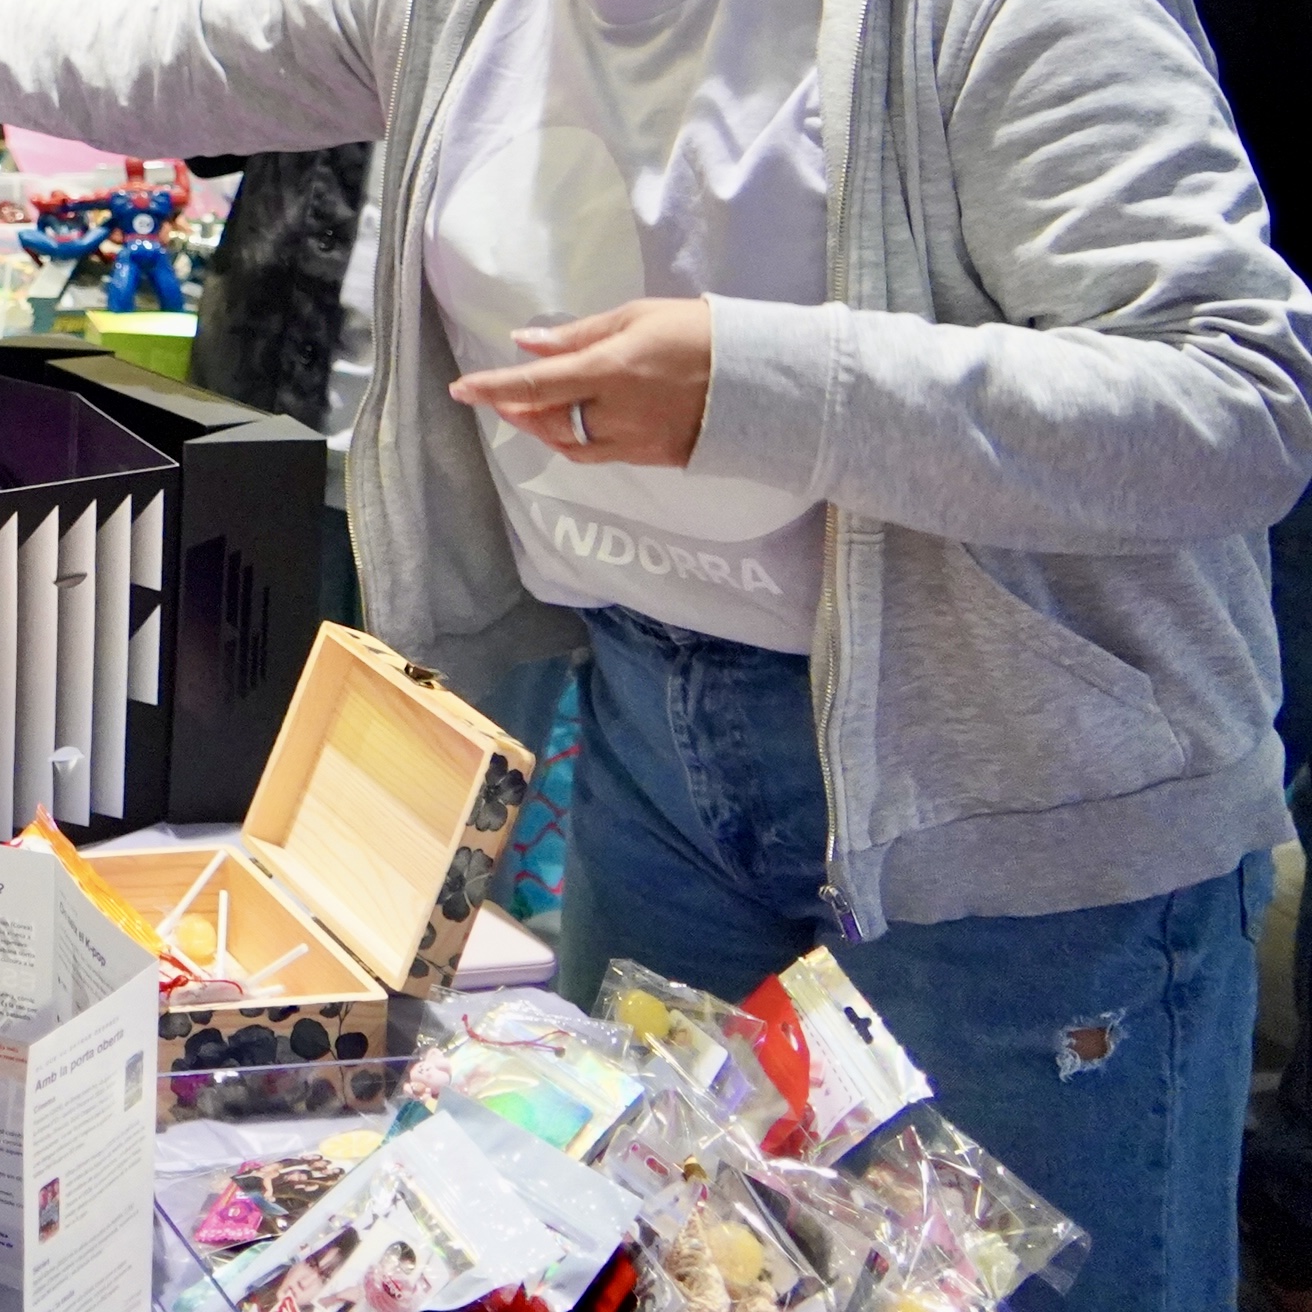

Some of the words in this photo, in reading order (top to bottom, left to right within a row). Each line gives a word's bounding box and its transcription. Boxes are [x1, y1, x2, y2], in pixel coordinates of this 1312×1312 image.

[35, 1072, 57, 1091] Amb
[60, 1064, 67, 1077] la
[70, 1050, 94, 1072] porta
[97, 1029, 124, 1054] oberta
